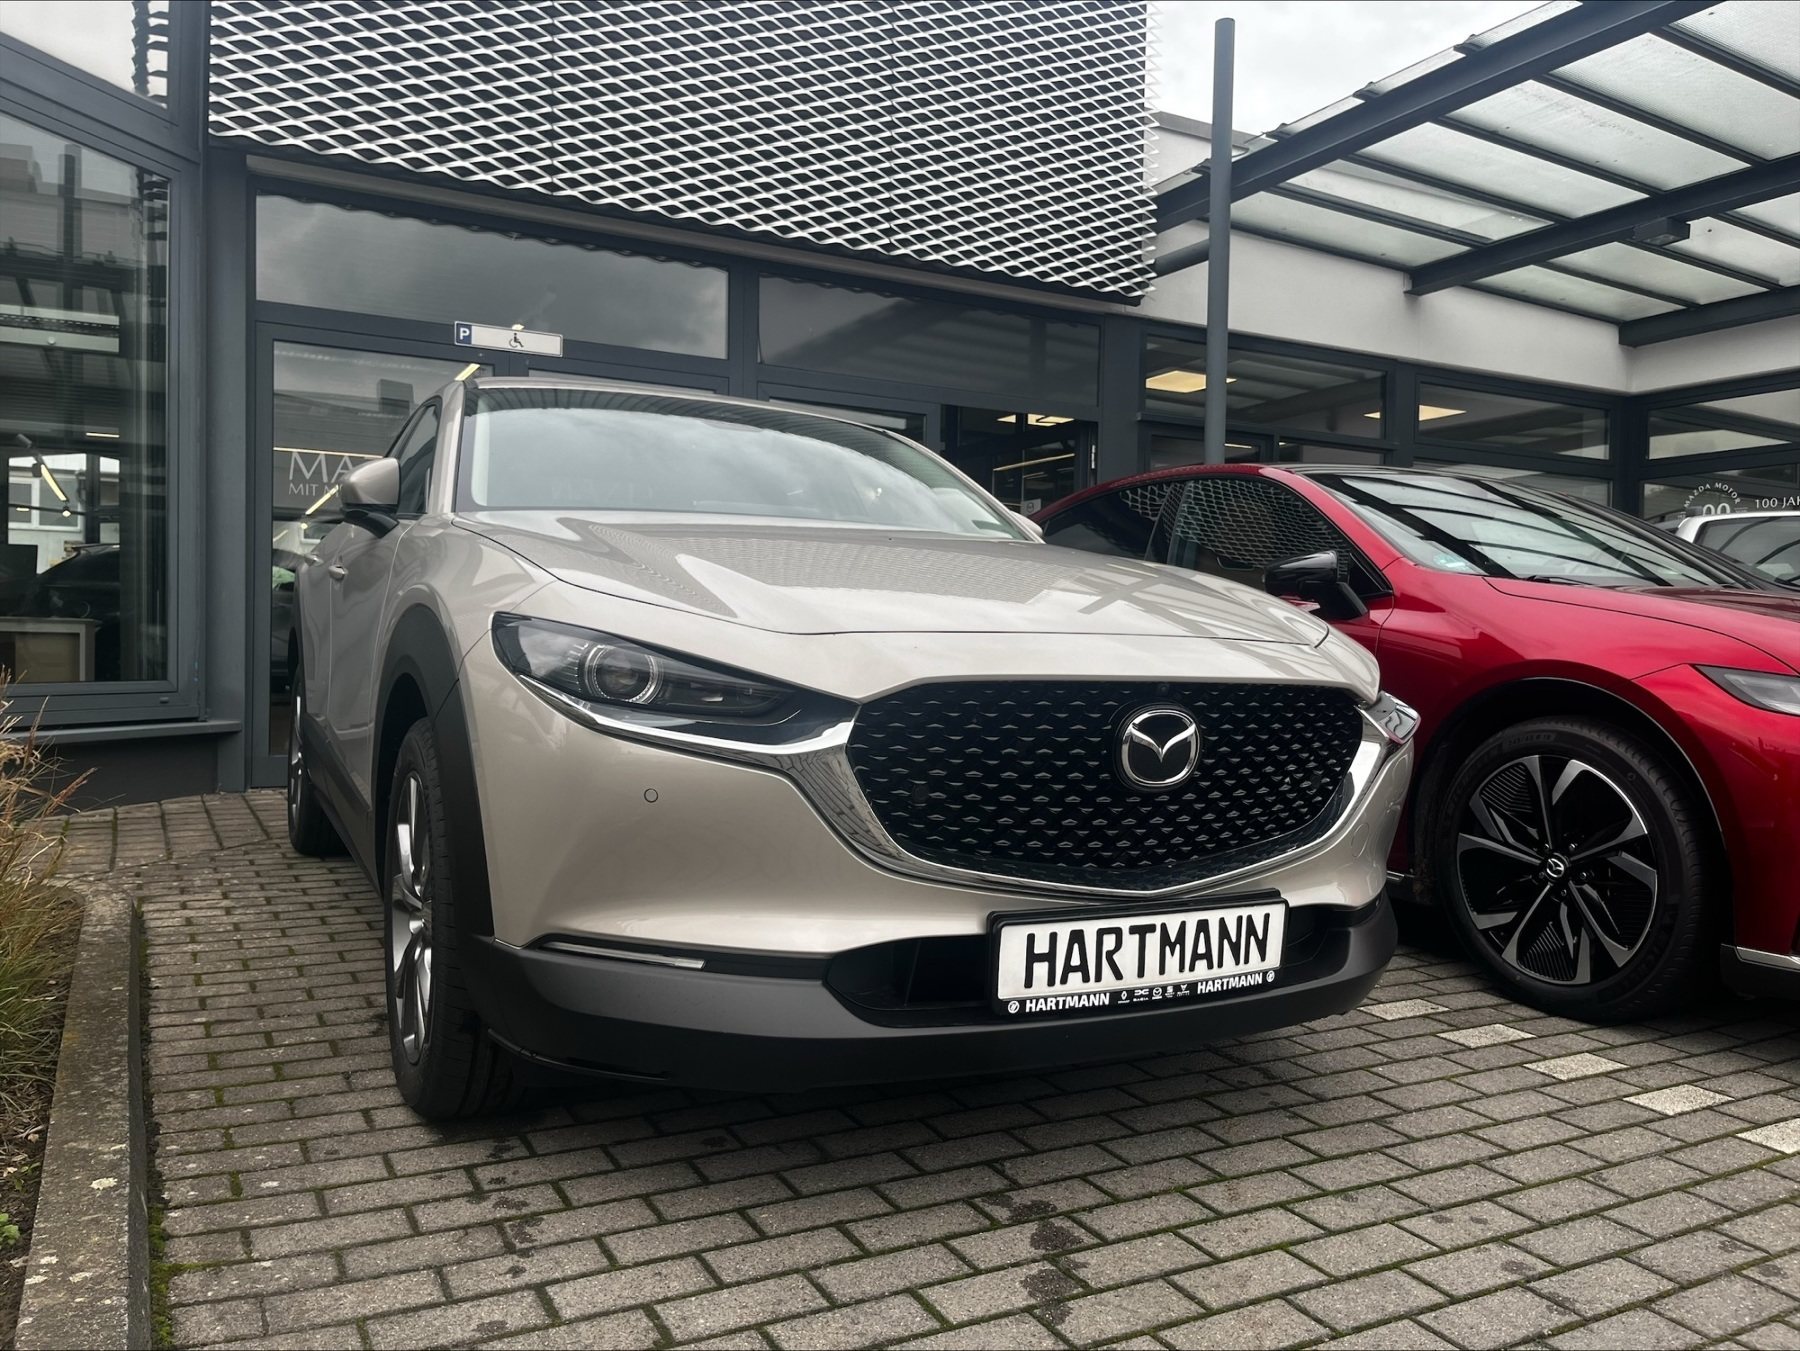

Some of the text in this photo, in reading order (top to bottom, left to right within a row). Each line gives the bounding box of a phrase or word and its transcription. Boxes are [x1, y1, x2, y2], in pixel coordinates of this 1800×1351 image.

[460, 327, 470, 340] P
[288, 451, 353, 483] MA
[288, 483, 319, 497] MIT
[1683, 482, 1741, 508] MAZDA MOTOR
[1755, 497, 1778, 509] 100
[1023, 912, 1271, 989] HARTMANN
[1025, 972, 1263, 1013] HARTMANN HARTMANN
